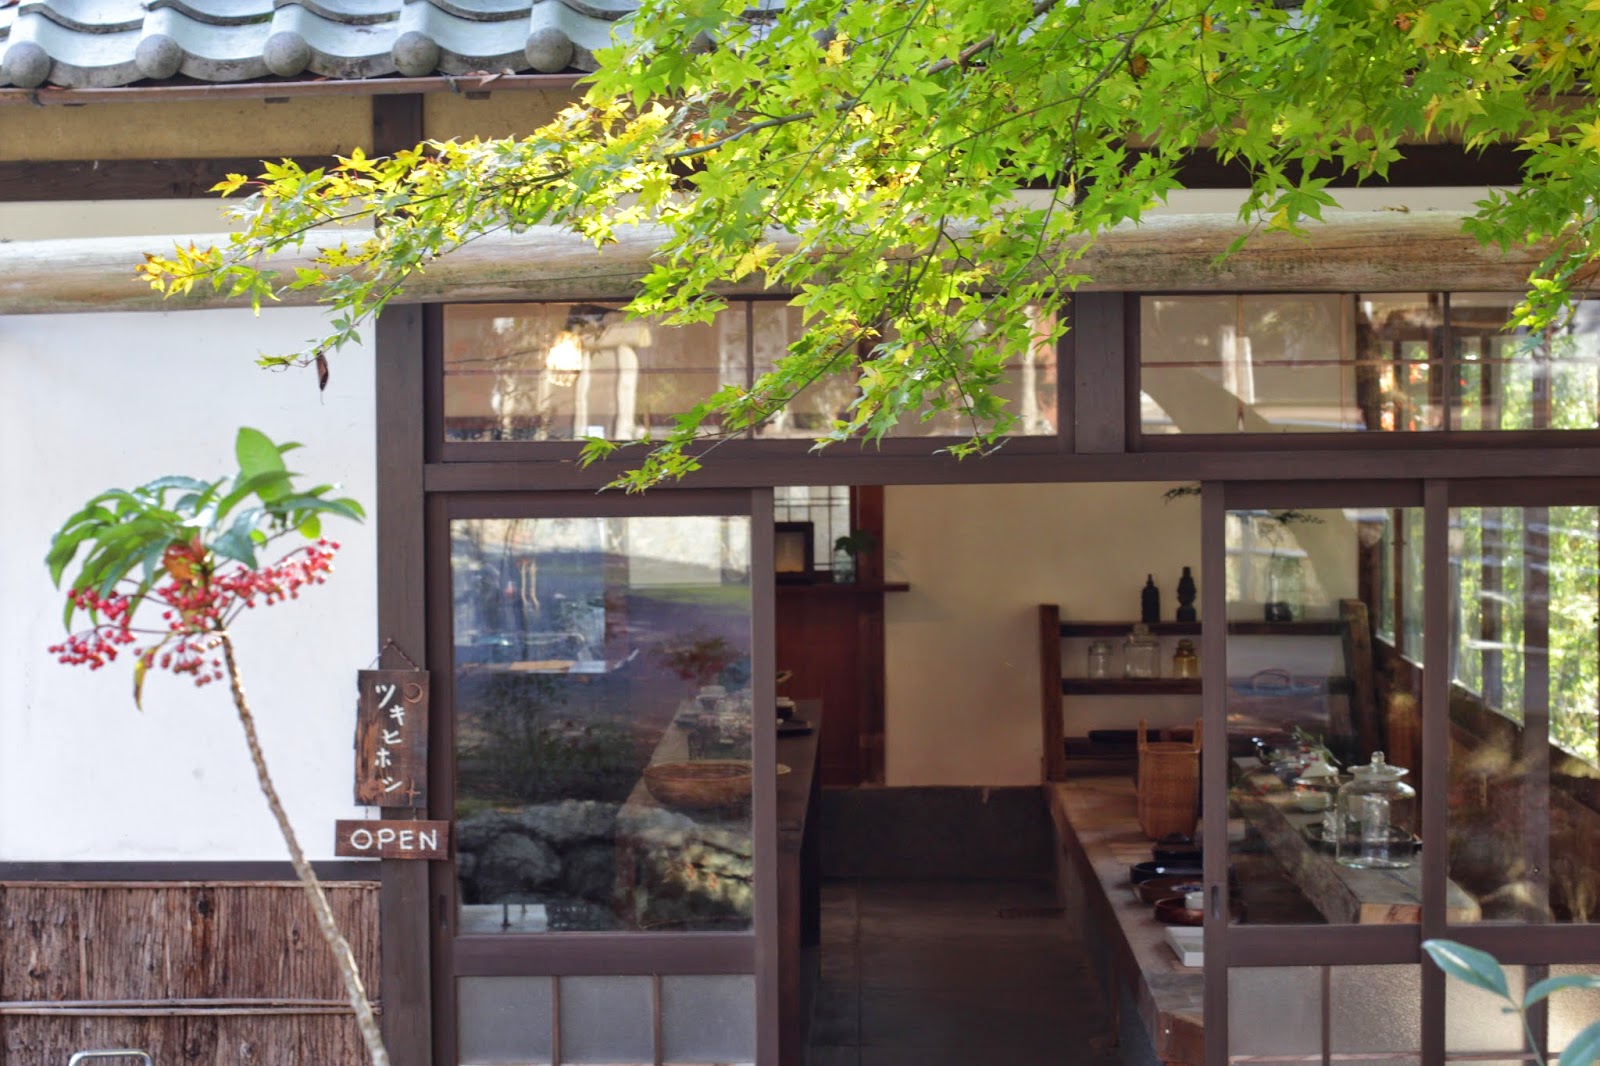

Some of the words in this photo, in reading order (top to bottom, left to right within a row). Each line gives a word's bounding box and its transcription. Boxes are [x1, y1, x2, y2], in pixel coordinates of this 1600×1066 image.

[374, 684, 405, 792] ツキヒホシ
[350, 828, 437, 851] OPEN
